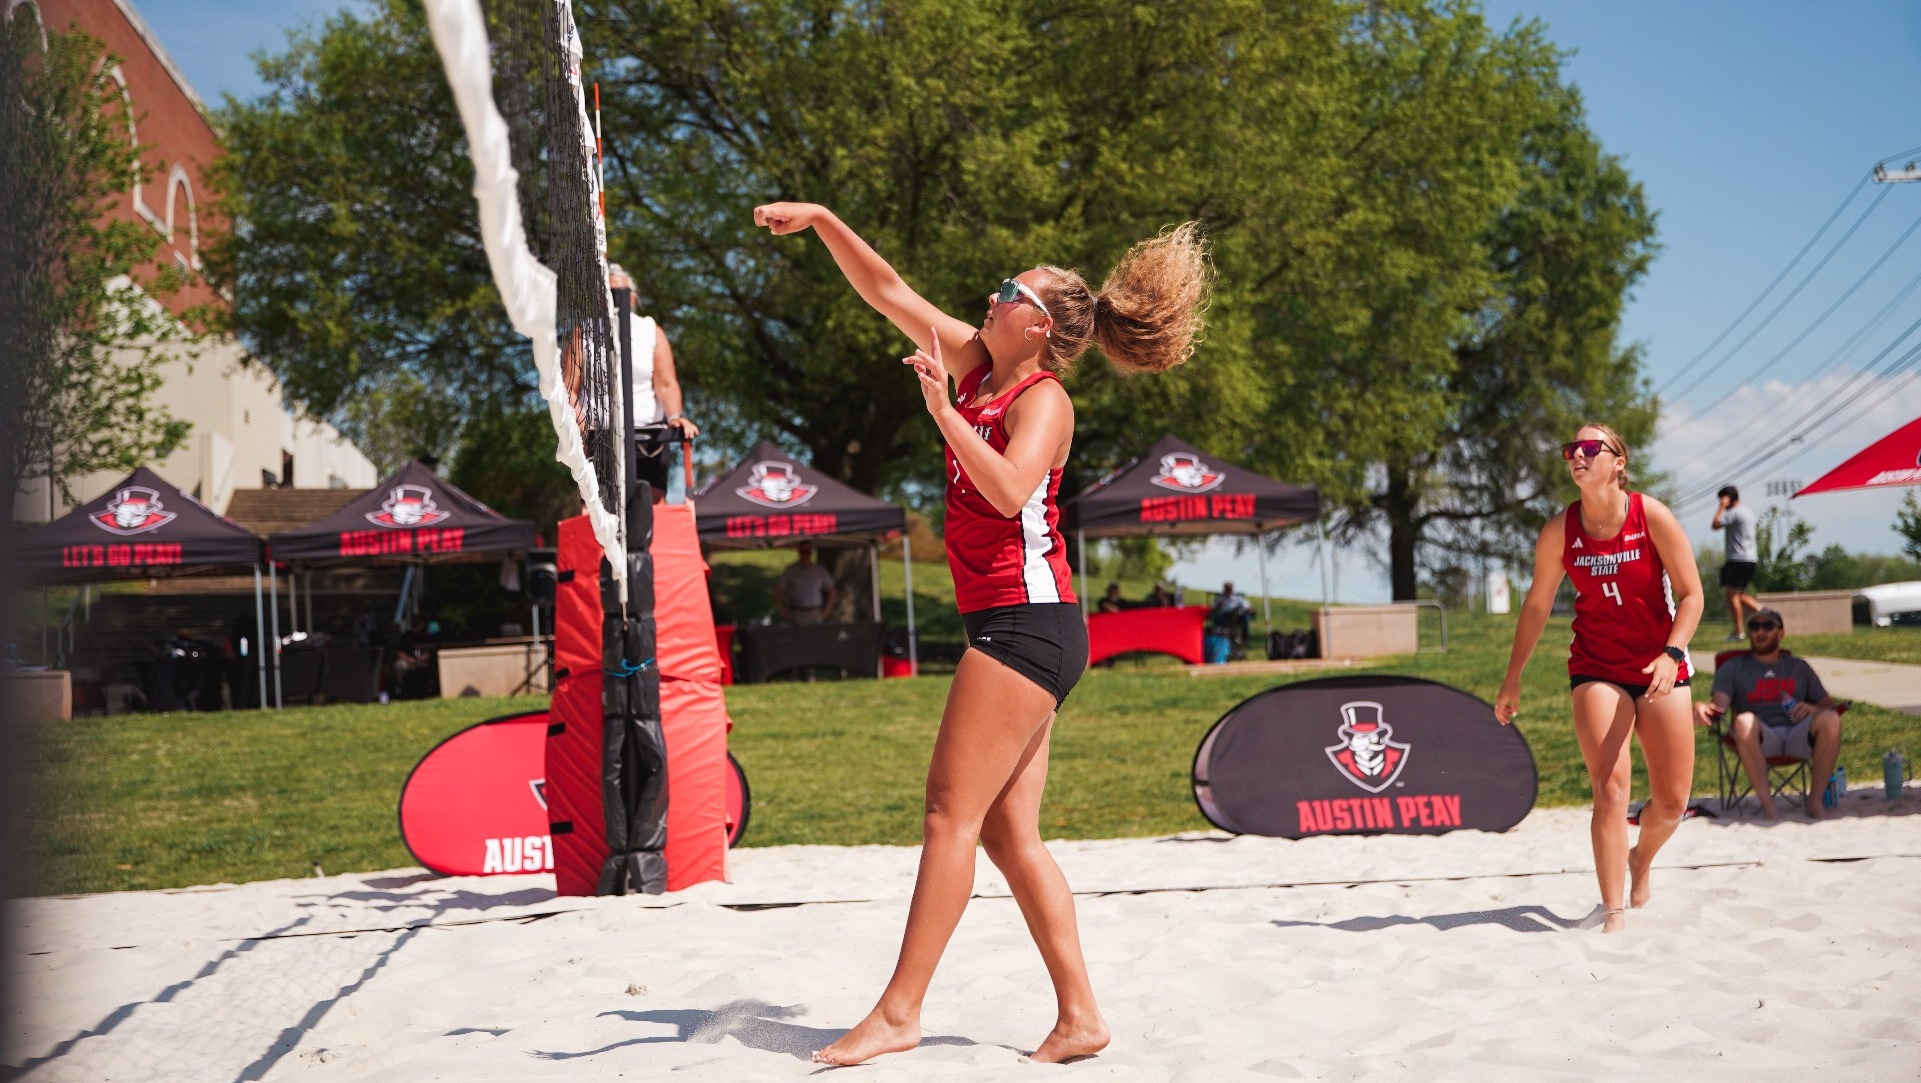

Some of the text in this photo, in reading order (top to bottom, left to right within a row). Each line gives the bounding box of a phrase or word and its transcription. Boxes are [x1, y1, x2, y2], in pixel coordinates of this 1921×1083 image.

[1140, 493, 1257, 522] AUSTIN PEAY
[767, 514, 790, 536] GO
[339, 527, 465, 556] AUSTIN PEAY
[63, 545, 105, 567] LET'S
[107, 544, 131, 566] GO
[1574, 549, 1640, 566] JACKSONVILLE
[1591, 564, 1618, 576] STATE
[1602, 582, 1623, 606] 4
[1296, 795, 1462, 832] AUSTIN PEAY
